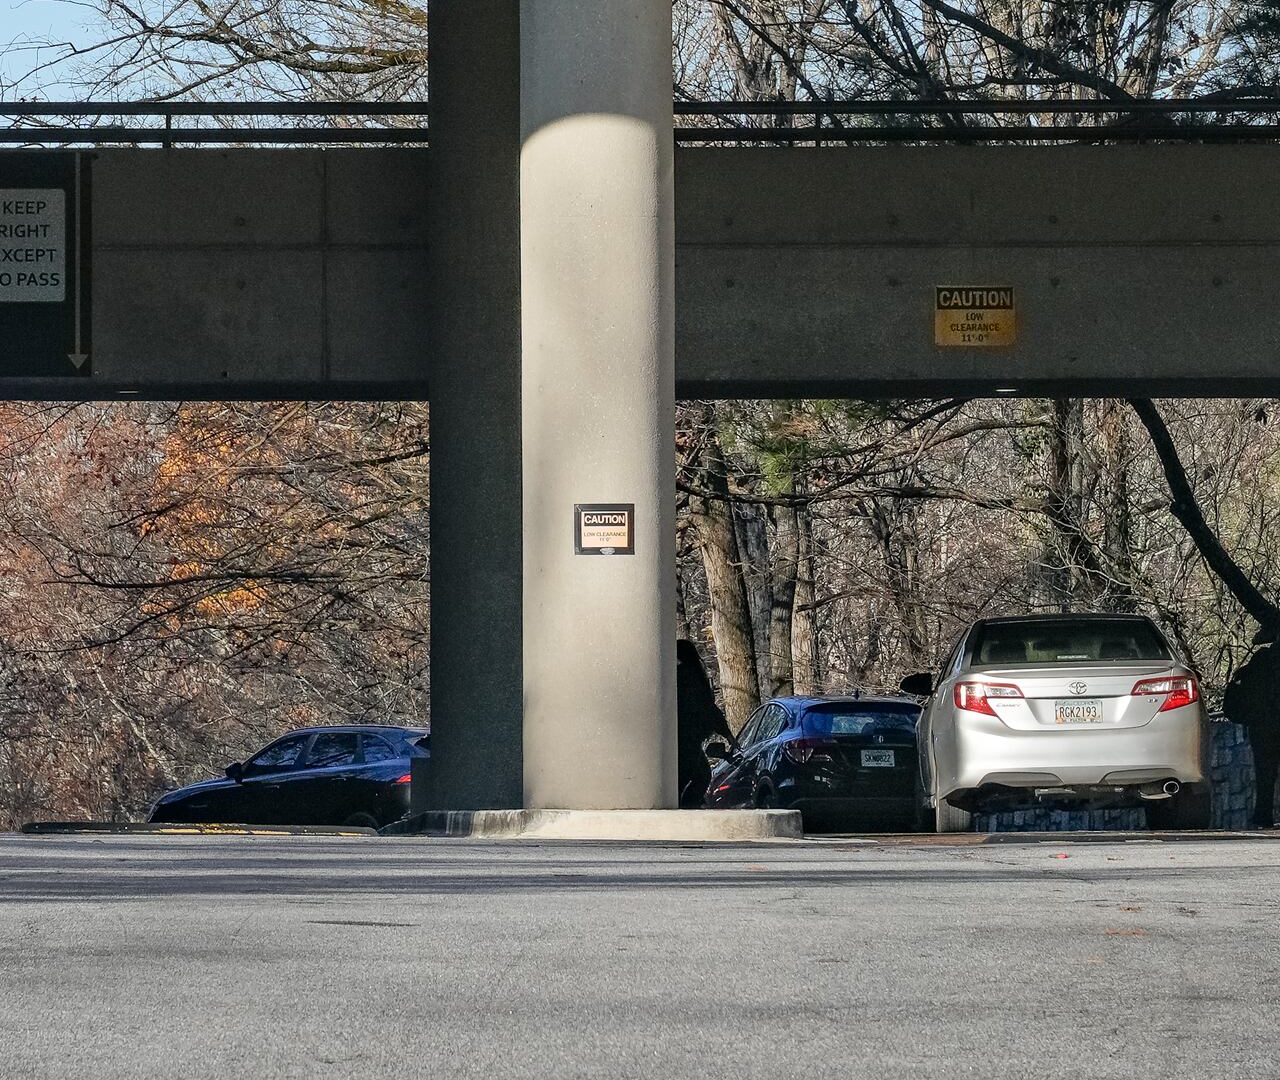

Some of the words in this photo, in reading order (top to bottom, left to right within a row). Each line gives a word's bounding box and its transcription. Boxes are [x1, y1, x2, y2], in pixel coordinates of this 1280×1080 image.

[2, 201, 47, 214] KEEP
[17, 273, 60, 286] PASS
[940, 290, 1010, 306] CAUTION
[950, 323, 1000, 331] CLEARANCE
[584, 515, 625, 524] CAUTION
[1059, 706, 1097, 718] RGK2193
